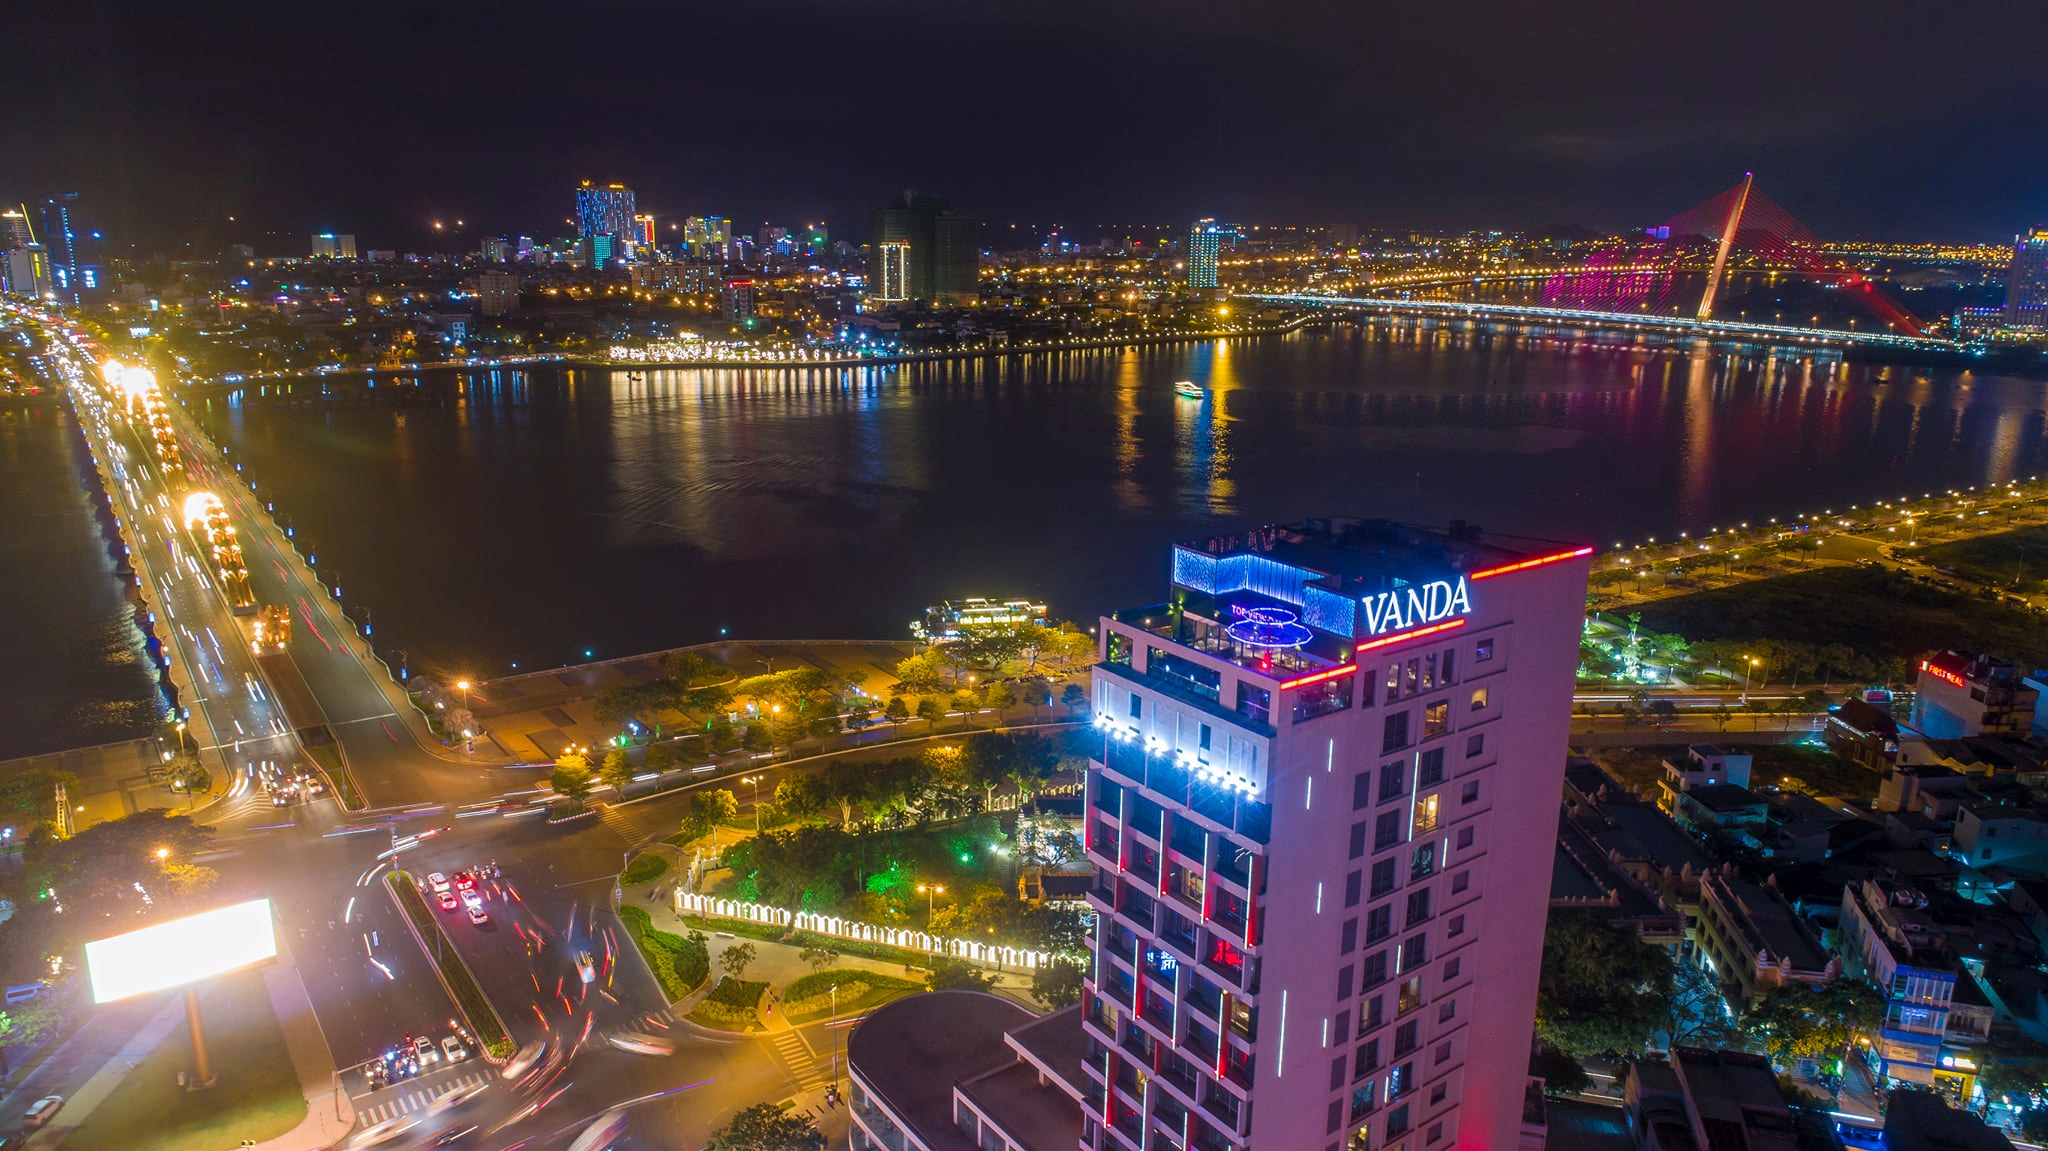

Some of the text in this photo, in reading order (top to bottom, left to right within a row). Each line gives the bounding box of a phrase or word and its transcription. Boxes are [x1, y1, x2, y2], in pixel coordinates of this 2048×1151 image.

[1231, 604, 1246, 617] TOP
[1362, 575, 1471, 635] VANDA
[1929, 664, 1965, 688] FIRST REAL
